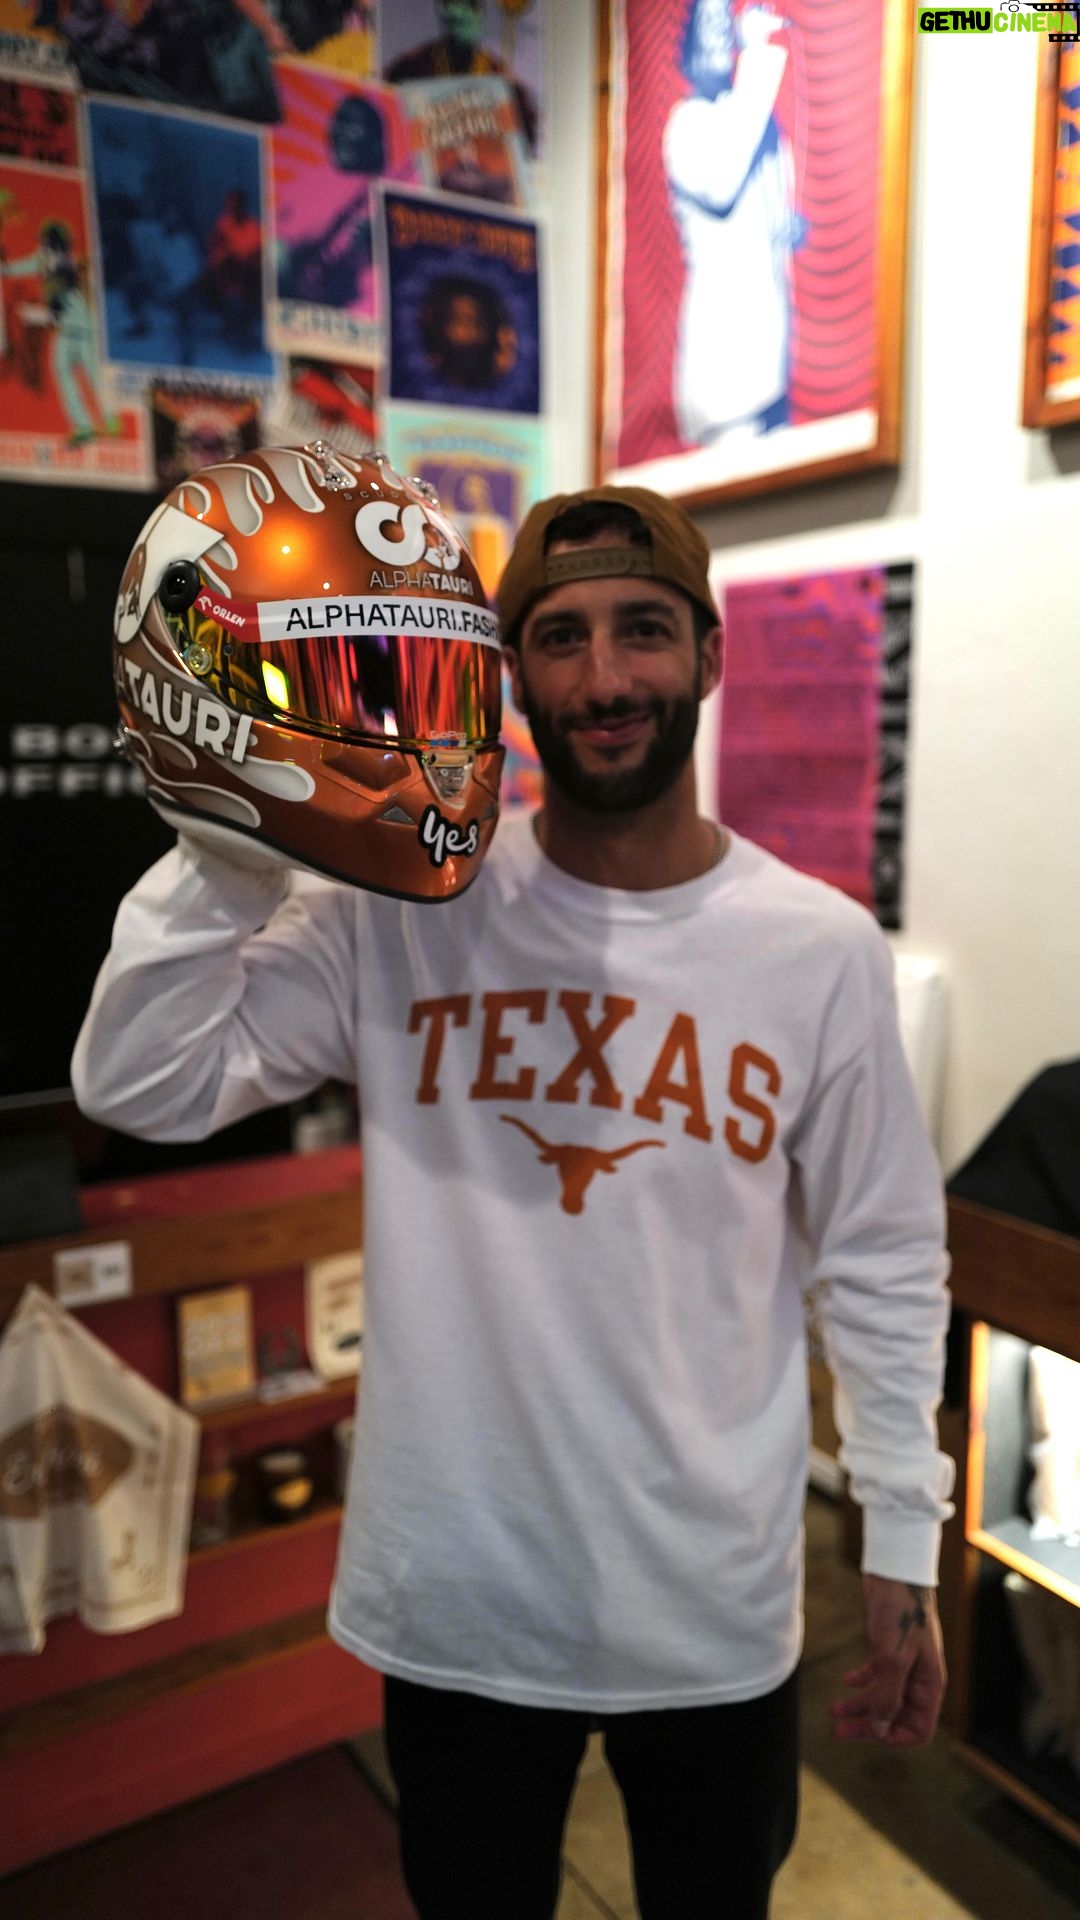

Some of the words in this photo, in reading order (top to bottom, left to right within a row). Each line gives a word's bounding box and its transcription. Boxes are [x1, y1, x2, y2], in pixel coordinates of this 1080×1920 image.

[370, 571, 475, 596] ALPHATAURI
[212, 604, 246, 628] ORLEN
[12, 723, 111, 761] BO
[408, 988, 783, 1166] TEXAS
